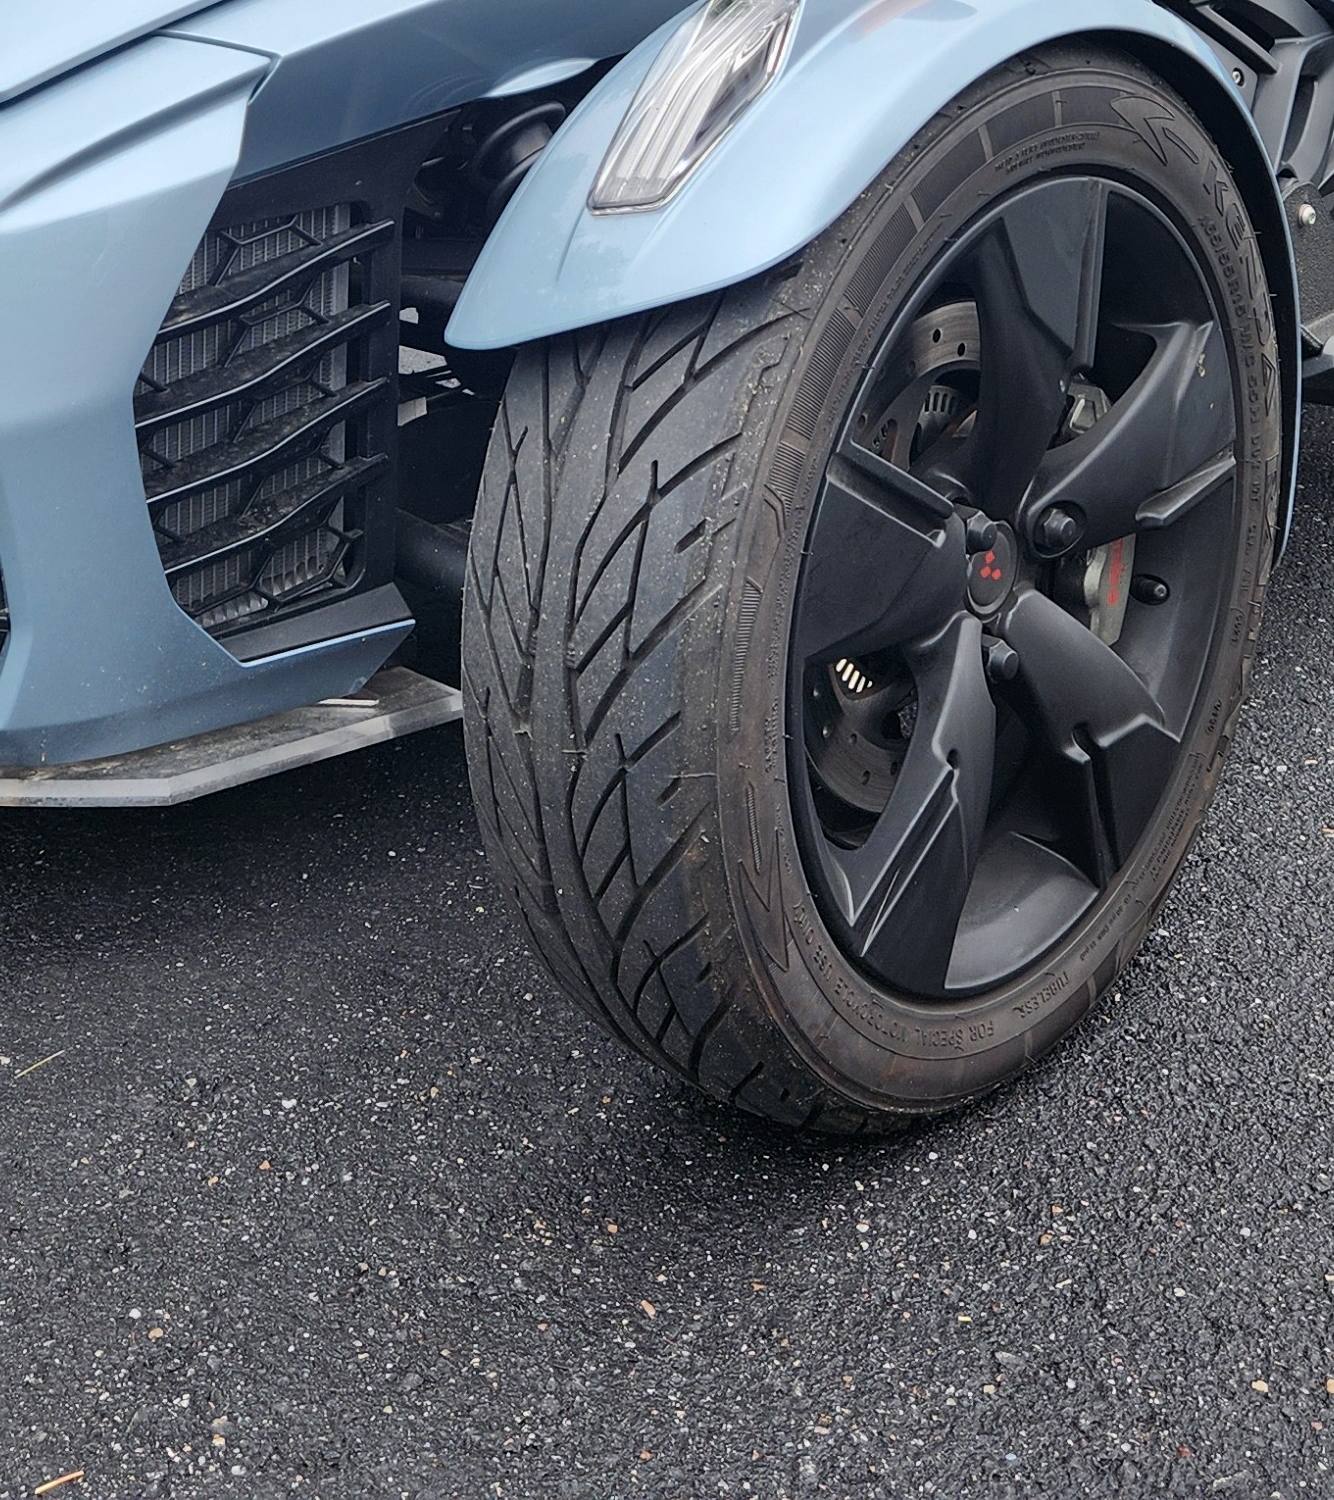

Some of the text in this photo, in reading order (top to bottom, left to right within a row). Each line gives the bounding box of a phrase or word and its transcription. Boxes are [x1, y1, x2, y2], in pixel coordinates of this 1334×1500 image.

[1202, 160, 1277, 417] KENDA
[915, 1026, 964, 1051] SPECIAL
[968, 1020, 994, 1044] FOR
